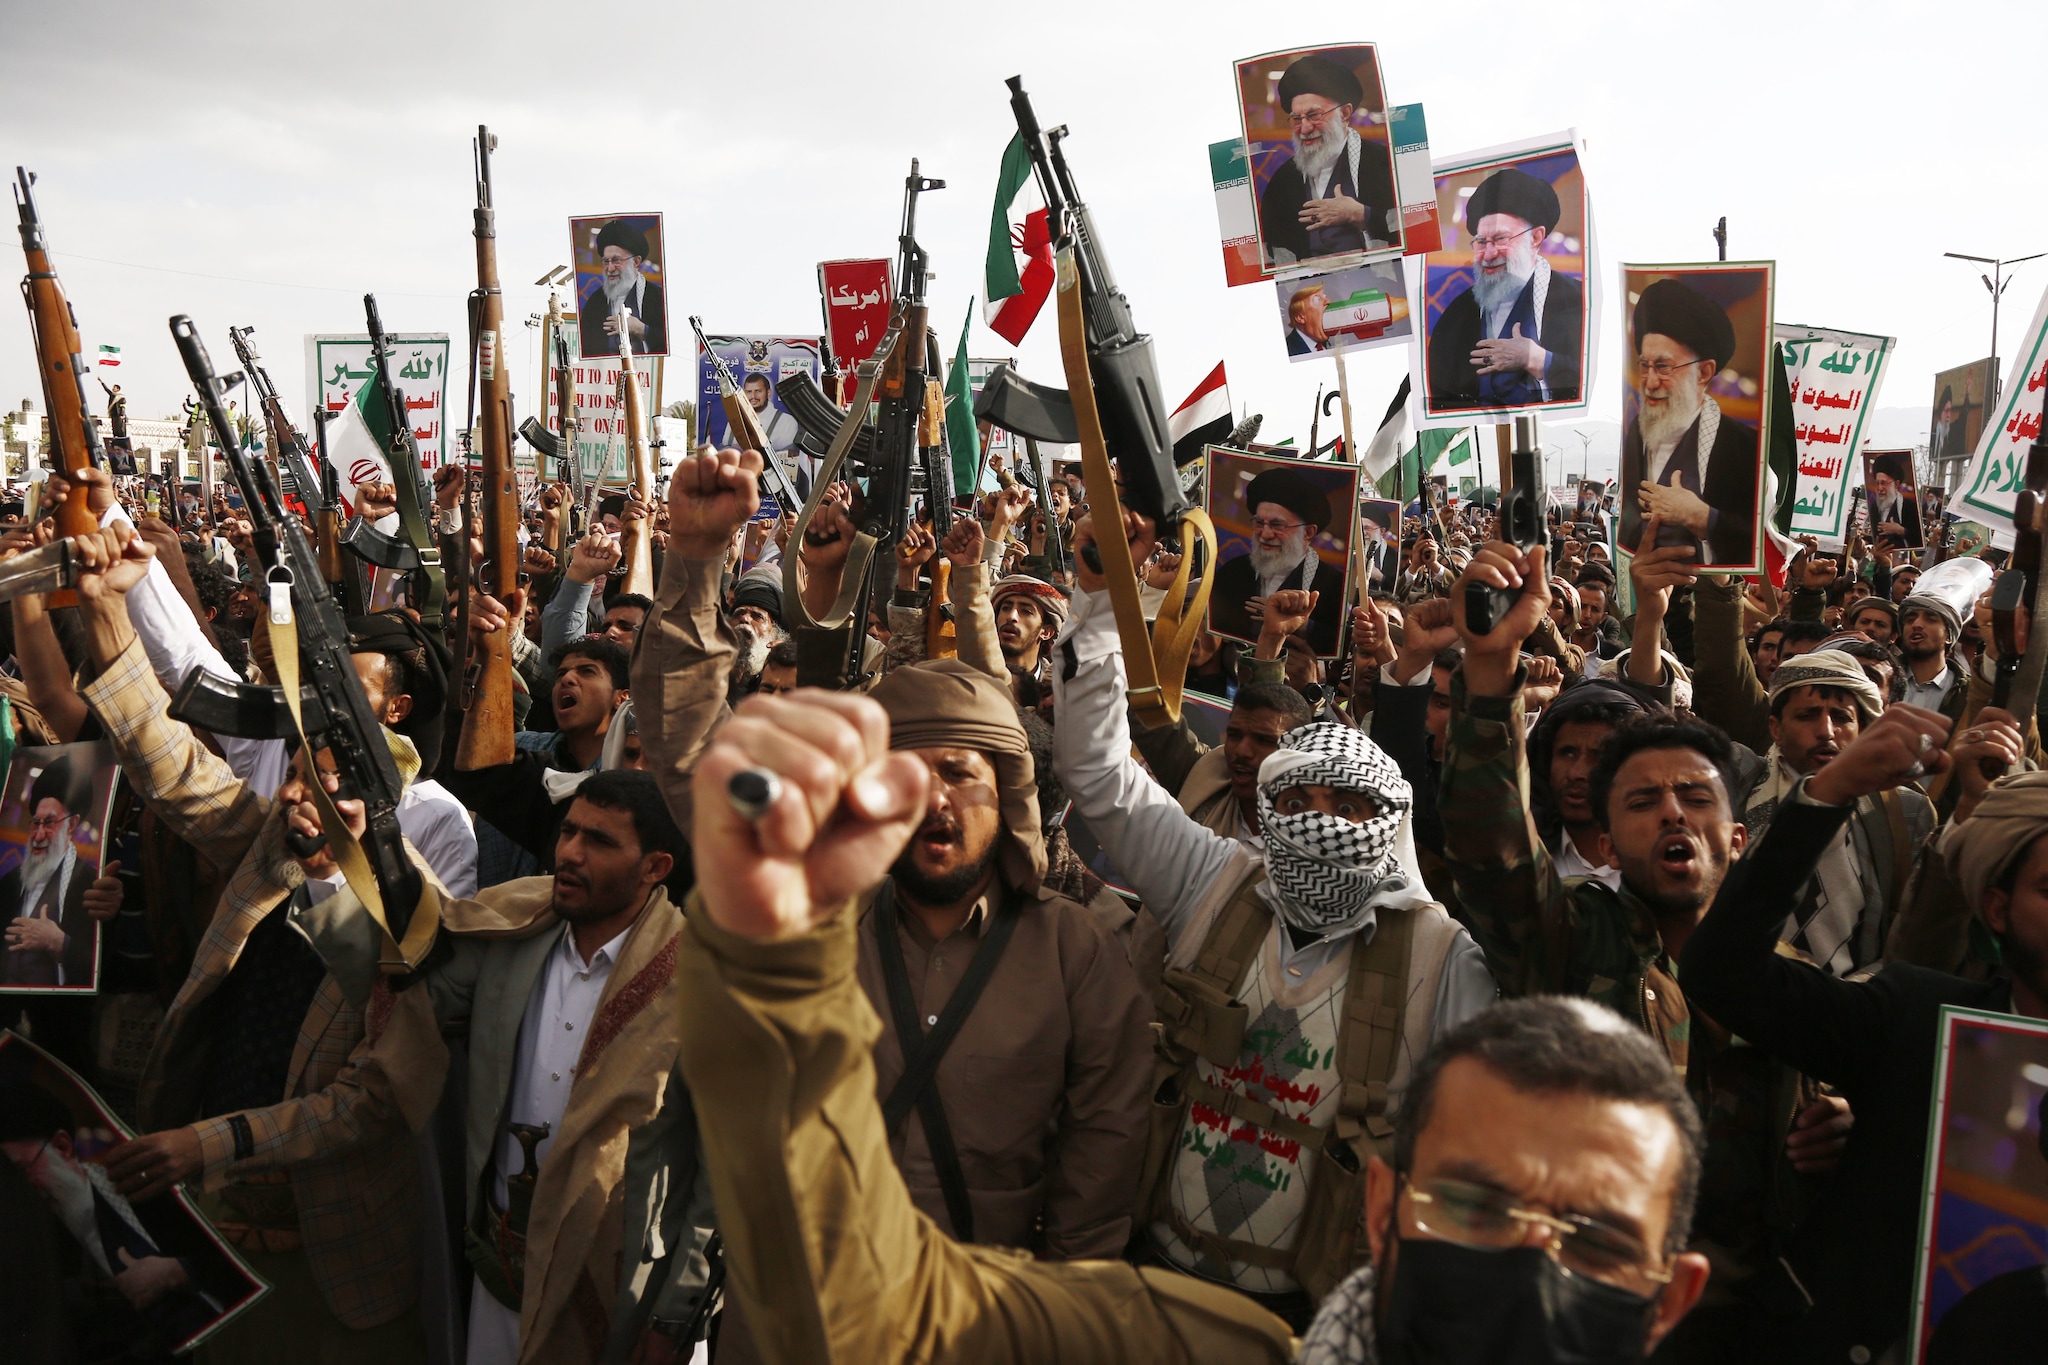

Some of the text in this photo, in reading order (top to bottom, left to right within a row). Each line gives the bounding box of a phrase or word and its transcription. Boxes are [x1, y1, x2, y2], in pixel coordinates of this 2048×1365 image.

[829, 276, 888, 311] أمريكا
[855, 320, 869, 346] أم
[399, 350, 443, 380] الله
[1784, 332, 1875, 376] الله أك
[588, 368, 602, 385] TO
[605, 370, 650, 388] AMCA
[405, 390, 440, 414] المو
[588, 394, 602, 409] TO
[1803, 387, 1861, 411] الموت
[594, 418, 610, 434] ON
[1795, 423, 1852, 446] الموت
[1798, 453, 1842, 480] اللعنة
[1793, 484, 1835, 518] النص
[1283, 1036, 1335, 1071] الله
[1263, 1075, 1320, 1107] الموت
